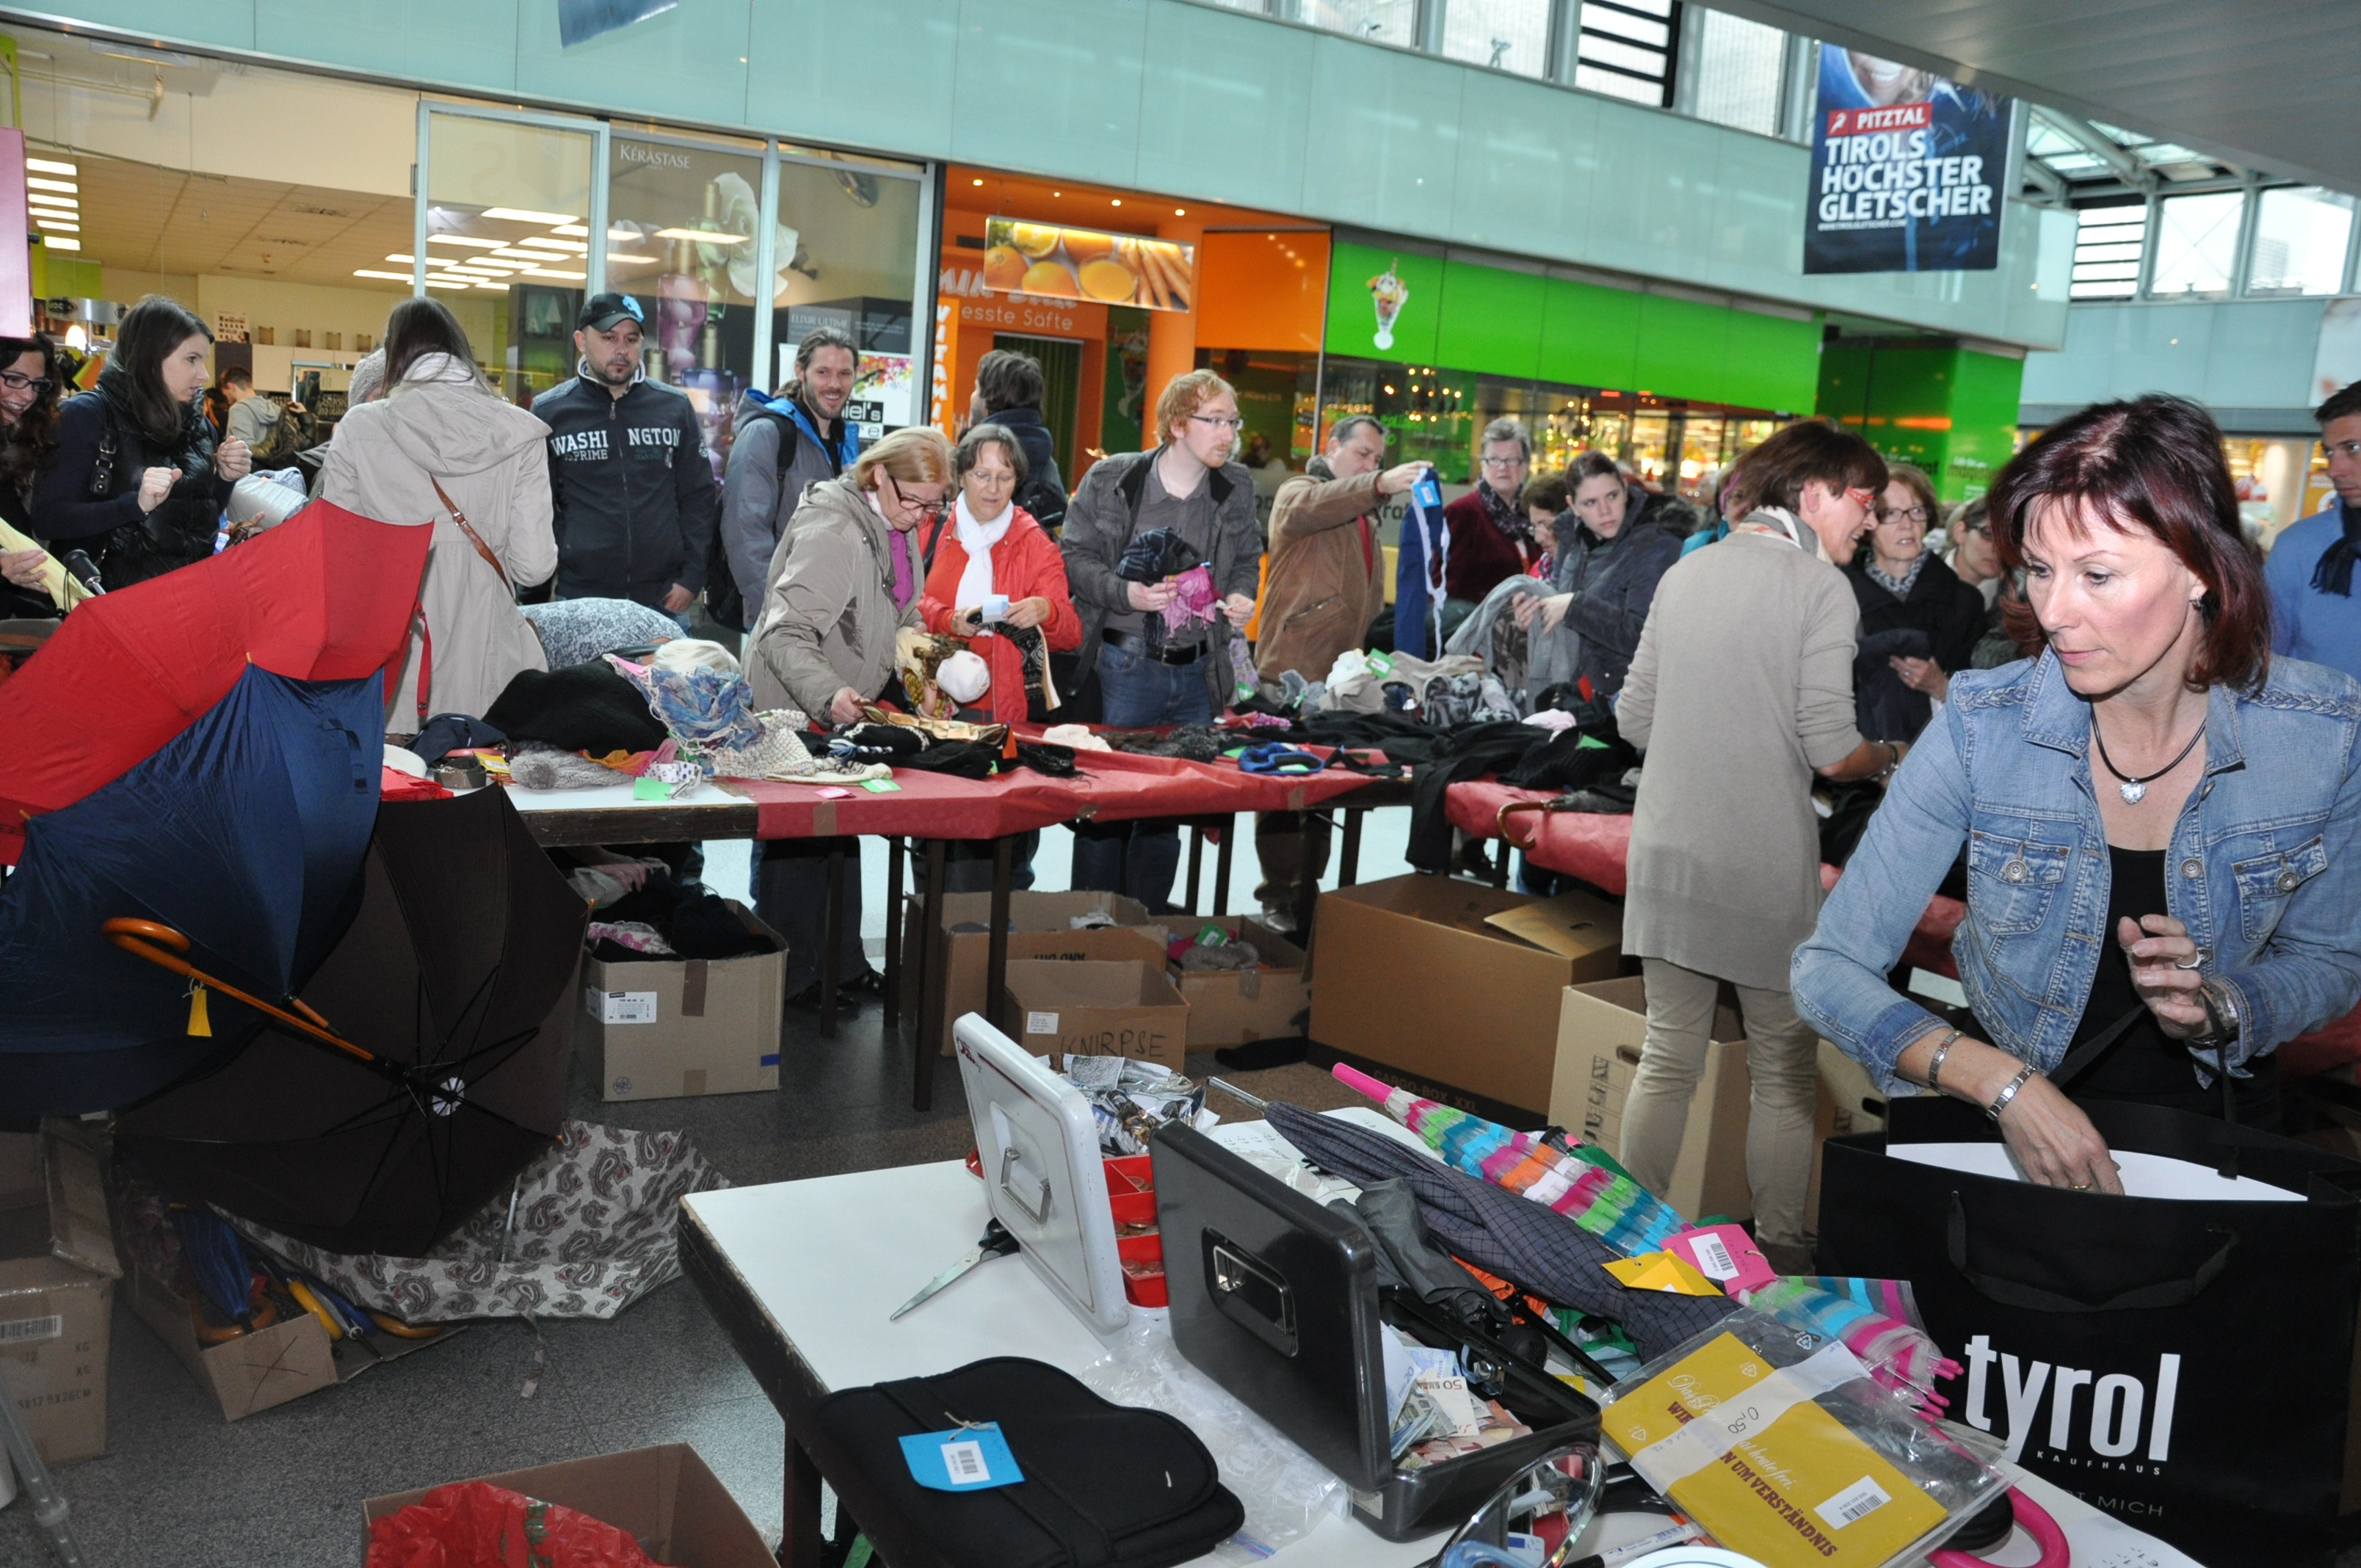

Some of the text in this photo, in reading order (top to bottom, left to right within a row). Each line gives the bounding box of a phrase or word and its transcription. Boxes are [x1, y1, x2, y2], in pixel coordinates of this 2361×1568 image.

[1857, 106, 1926, 131] PITZTAL
[620, 143, 691, 170] KÉRASTASE
[1825, 129, 1927, 166] TIROLS
[1821, 155, 1984, 195] HÖCHSTER
[1818, 184, 1993, 222] GLETSCHER
[1023, 308, 1073, 330] Säfte
[550, 429, 609, 457] WASHI
[627, 427, 681, 447] NGTON
[1060, 1028, 1167, 1057] KNIRPSE
[1443, 1379, 1462, 1390] 50
[1964, 1335, 2181, 1463] tyrol
[2037, 1451, 2161, 1476] KAUFHAUS
[1730, 1459, 1756, 1484] UM
[1749, 1478, 1839, 1558] VERSTÄNDNIS
[2097, 1495, 2164, 1517] MICH
